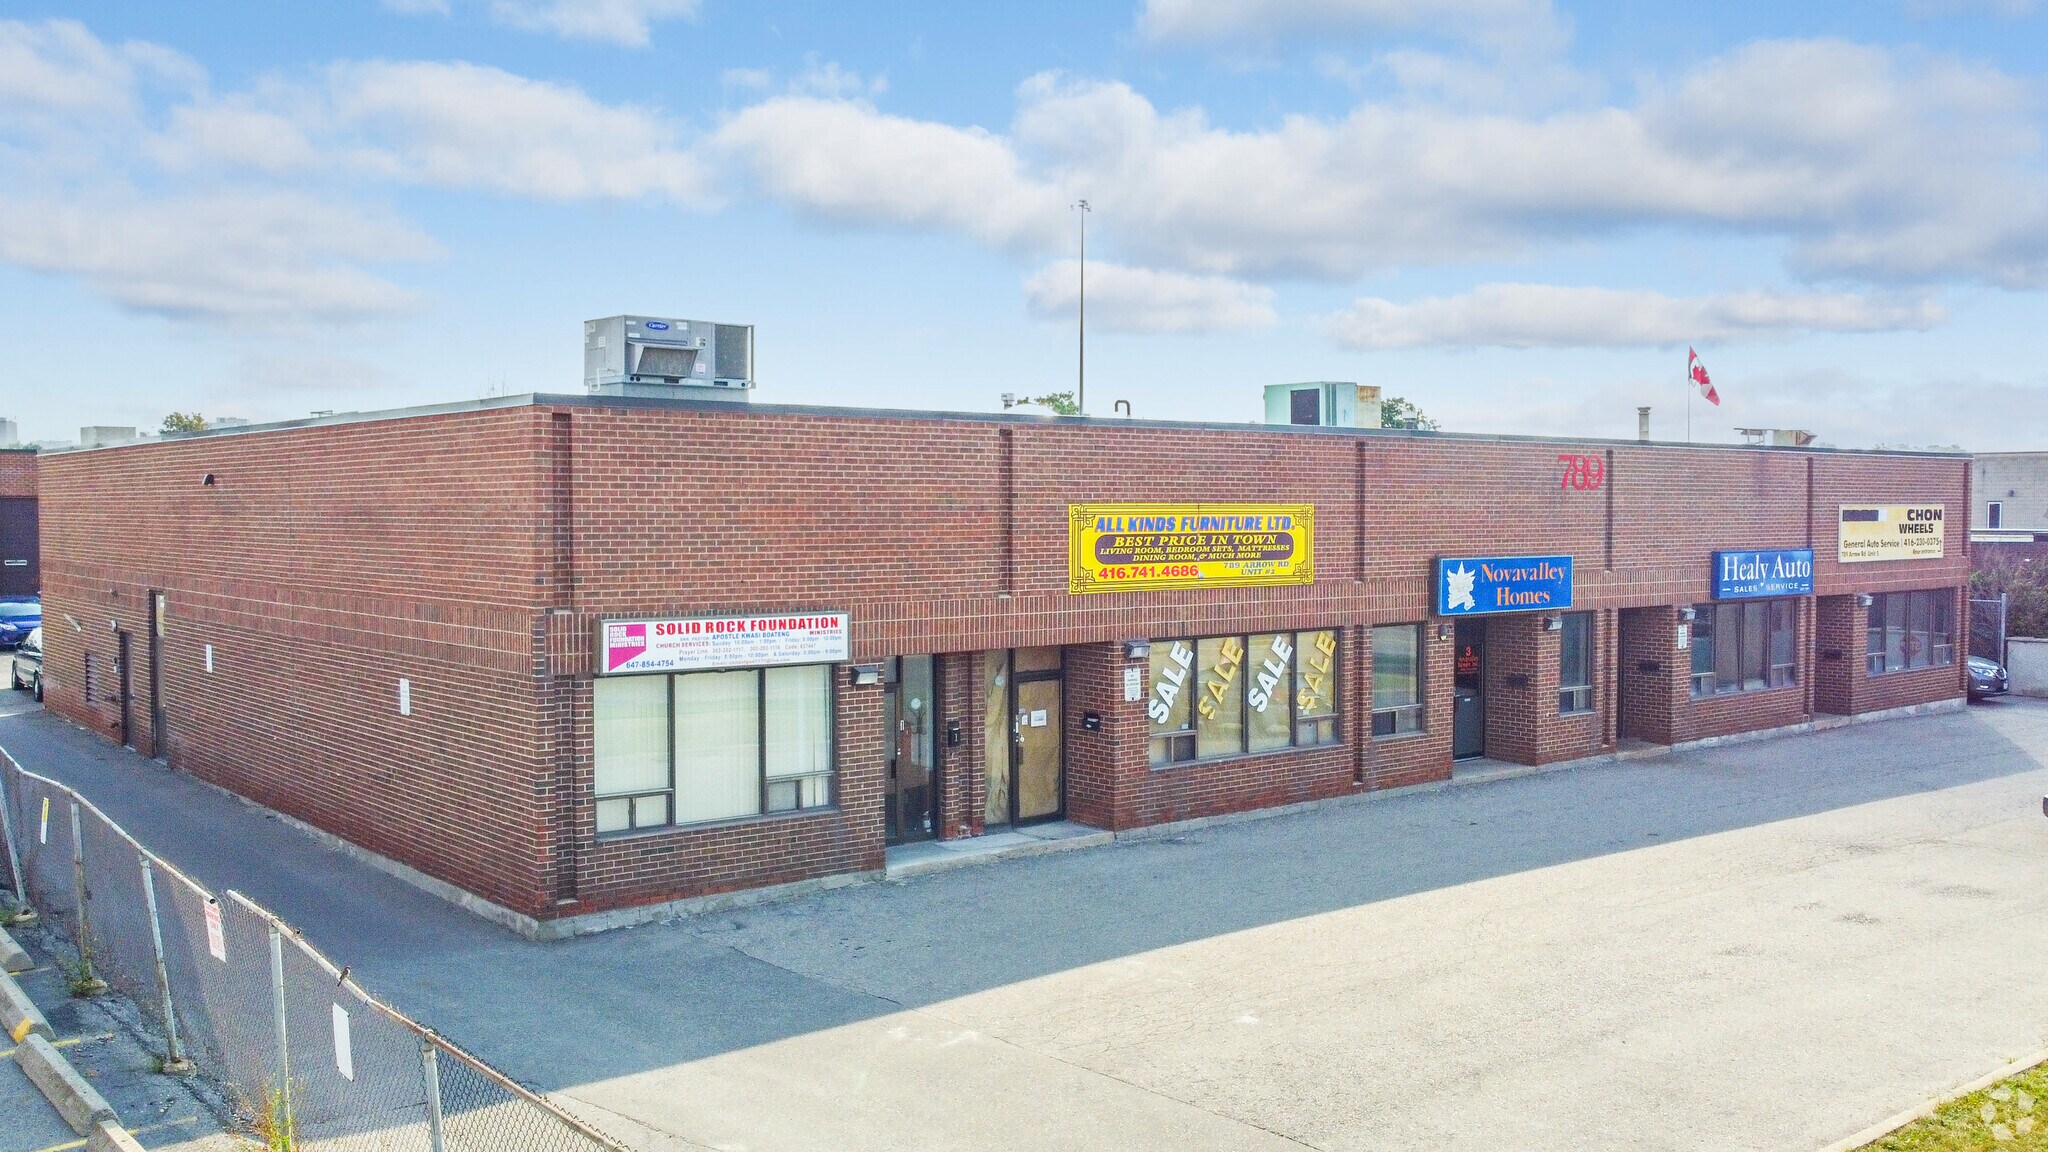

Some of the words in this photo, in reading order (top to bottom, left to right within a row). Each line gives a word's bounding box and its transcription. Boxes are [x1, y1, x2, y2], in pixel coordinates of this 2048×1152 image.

[1558, 454, 1603, 490] 789
[1907, 508, 1942, 521] CHON
[1095, 516, 1124, 532] ALL
[1128, 516, 1176, 532] KINDS
[1180, 516, 1263, 531] FURNITURE
[1267, 516, 1295, 530] LTD.
[1899, 523, 1934, 534] WHEELS
[1114, 536, 1154, 547] BEST
[1158, 536, 1206, 546] PRICE
[1210, 535, 1228, 545] IN
[1233, 535, 1277, 544] TOWN
[1844, 540, 1865, 548] General
[1099, 565, 1198, 579] 416.741.4686
[1482, 562, 1567, 584] Novavalley
[1722, 554, 1768, 586] Healy
[1772, 554, 1811, 578] Auto
[1766, 583, 1798, 591] SERVICE
[1497, 587, 1550, 606] Homes
[656, 622, 700, 636] SOLID
[705, 620, 746, 633] ROCK
[751, 617, 838, 631] FOUNDATION
[1466, 646, 1471, 657] 3
[626, 660, 674, 668] 647-854-4754
[1297, 632, 1337, 710] SALE
[1149, 640, 1194, 724] SALE
[1199, 637, 1244, 720] SALE
[1248, 635, 1294, 713] SALE
